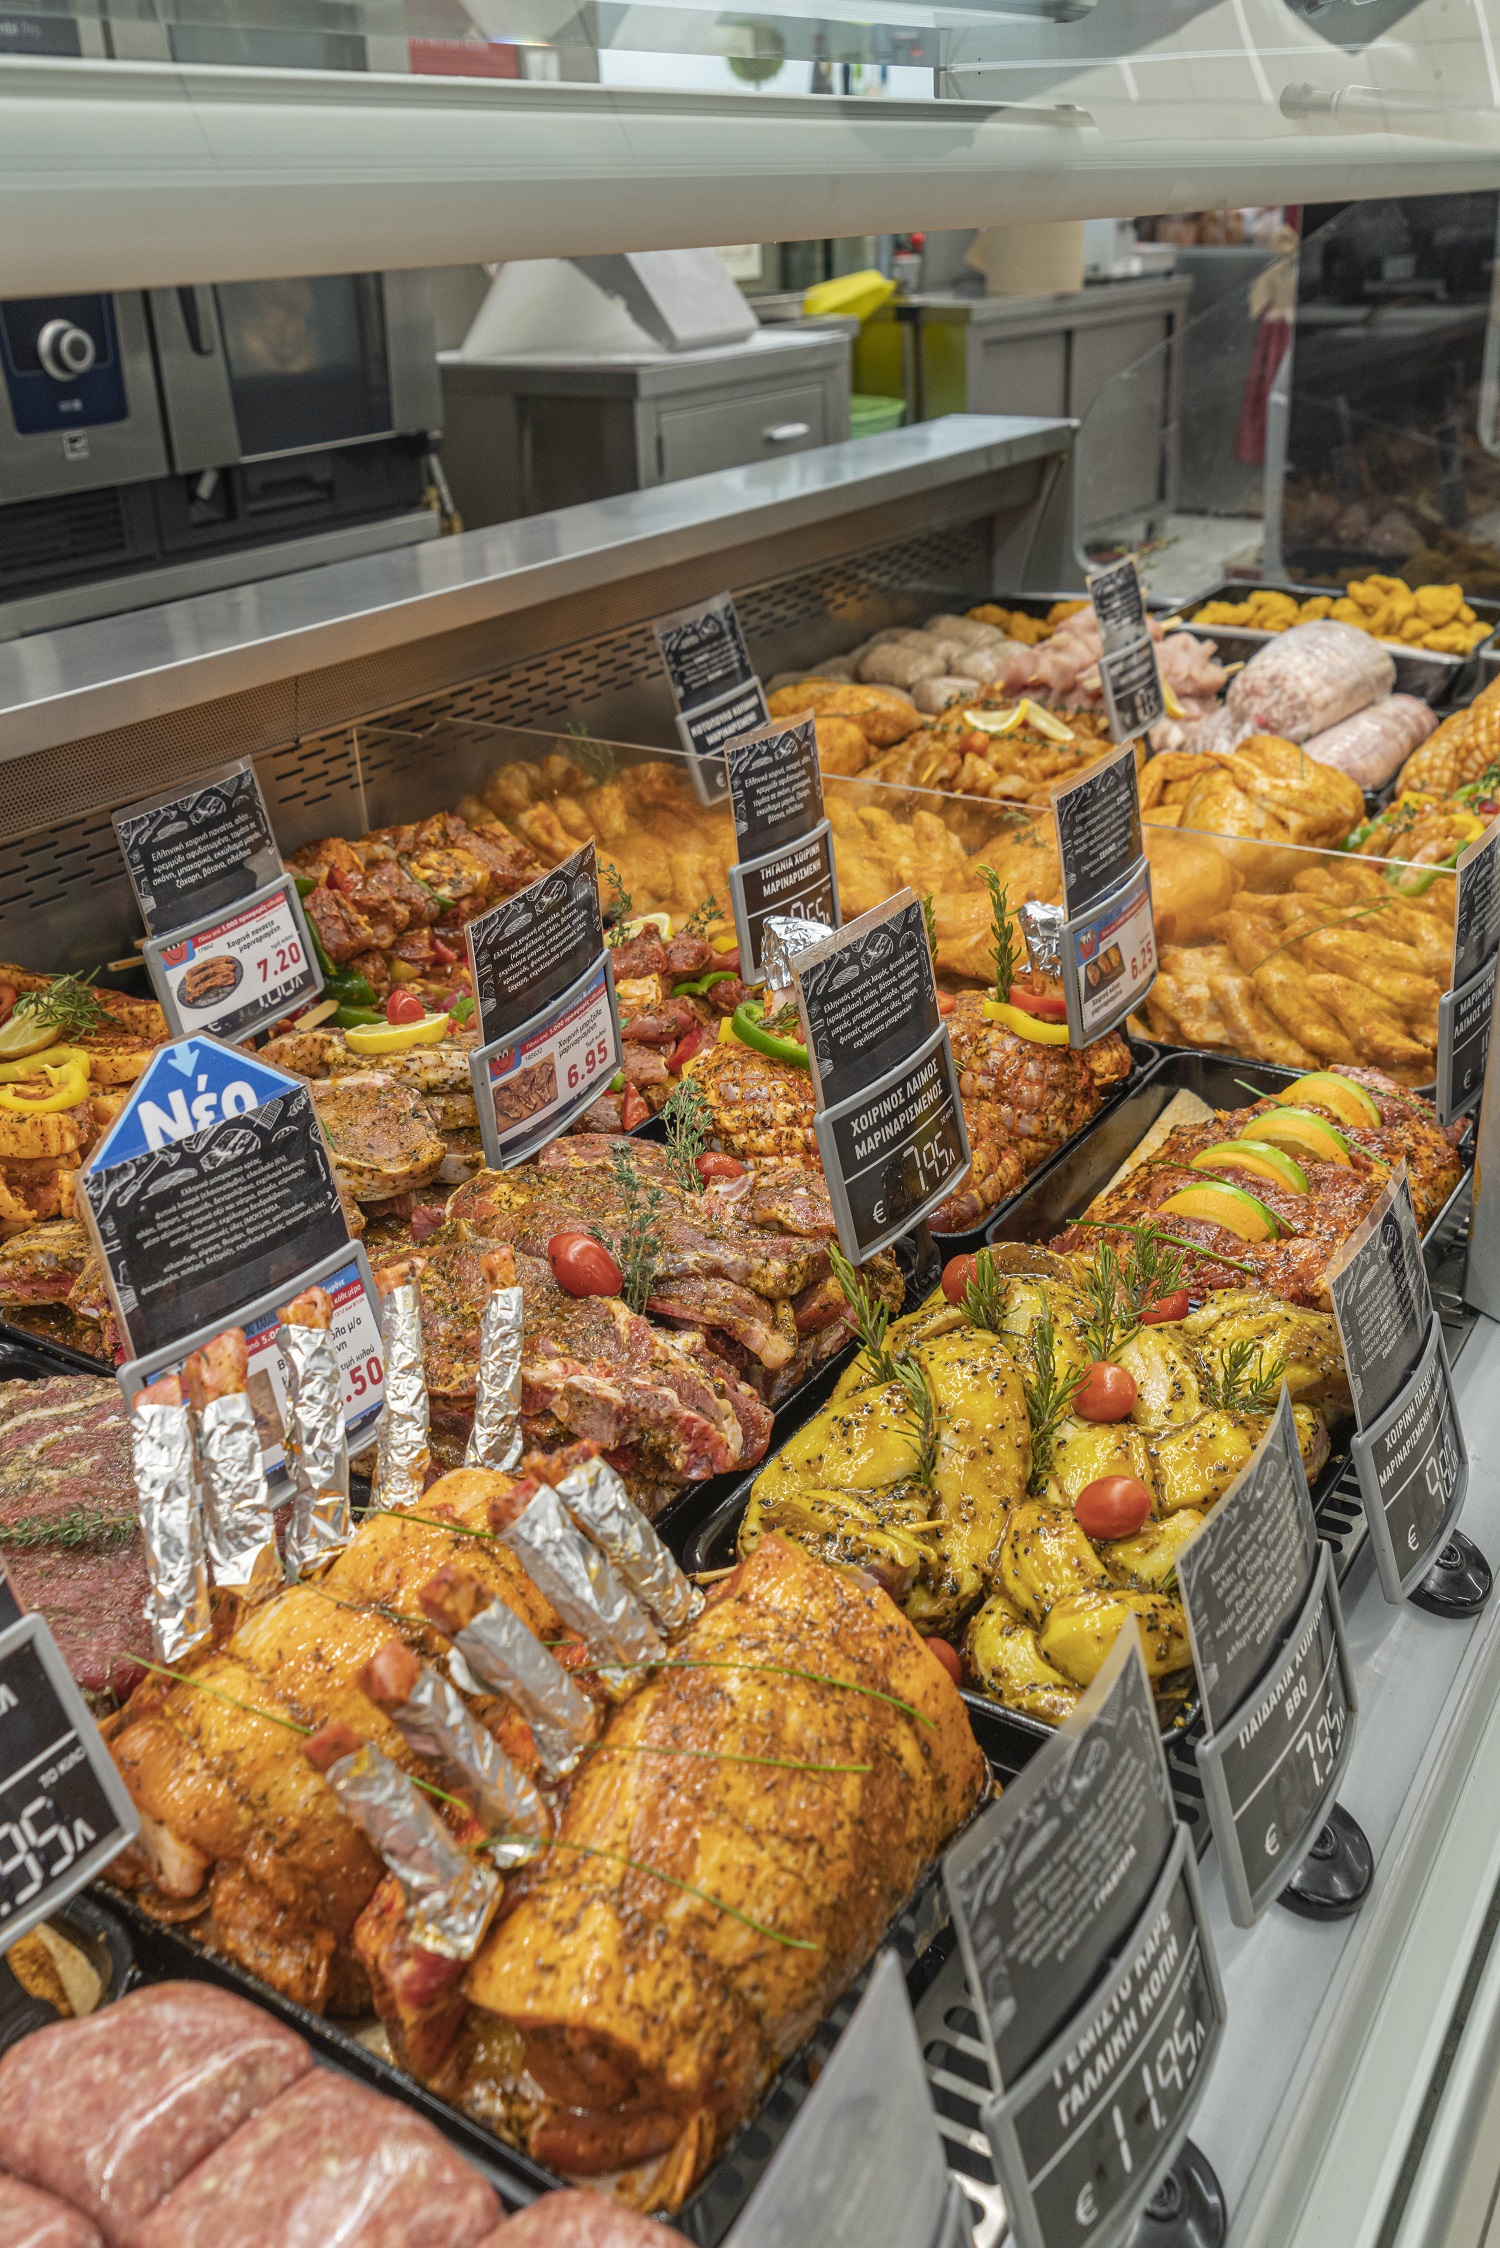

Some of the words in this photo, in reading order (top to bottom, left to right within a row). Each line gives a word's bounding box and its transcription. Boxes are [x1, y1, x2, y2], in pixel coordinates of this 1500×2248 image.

[760, 857, 793, 880] ΤΗΓΑΝΙΑ
[794, 842, 820, 865] ΧΟΙΡΙΝΗ
[763, 859, 821, 896] ΜΑΡΙΝΑΡΙΣΜΕΝΗ
[226, 932, 250, 949] Χοιρινή
[1131, 940, 1152, 980] 6.25
[257, 942, 300, 982] 7.20
[823, 992, 850, 1013] Ελληνικός
[850, 979, 871, 998] χοιρινός
[1460, 969, 1495, 1014] ΜΑΡΙΝΑΤΟΣ
[549, 1020, 564, 1034] 5.000
[558, 1027, 579, 1048] Χοιρινή
[579, 1009, 602, 1032] μπριζόλα
[1454, 1005, 1480, 1039] ΛΑΙΜΟΣ
[1482, 993, 1491, 1012] ΜΕ
[567, 1039, 607, 1088] 6.95
[137, 1073, 259, 1152] Νέο
[851, 1088, 904, 1136] ΧΟΙΡΙΝΟΣ
[906, 1058, 938, 1097] ΛΑΙΜΟΣ
[855, 1080, 942, 1158] ΜΑΡΙΝΑΡΙΣΜΕΝΟΣ
[872, 1200, 886, 1224] €
[334, 1292, 346, 1304] κάθε
[346, 1284, 361, 1298] μέρα
[340, 1357, 355, 1371] τιμή
[355, 1344, 375, 1361] κιλού
[1379, 1393, 1430, 1486] ΜΑΡΙΝΑΡΙΣΜΕΝΗ
[1385, 1392, 1415, 1451] ΧΟΙΡΙΝΗ
[1407, 1524, 1419, 1550] €
[1239, 1651, 1293, 1747] ΠΑΙΔΑΚΙΑ
[1291, 1598, 1322, 1668] ΧΟΙΡΙΝΑ
[1285, 1675, 1307, 1720] BBQ
[1265, 1823, 1279, 1855] €
[1053, 1963, 1131, 2086] ΓΕΜΙΣΤΟ
[1059, 2010, 1137, 2124] ΓΑΛΛΙΚΗ
[1139, 1935, 1181, 2015] ΚΟΠΗ
[1074, 2178, 1099, 2227] €
